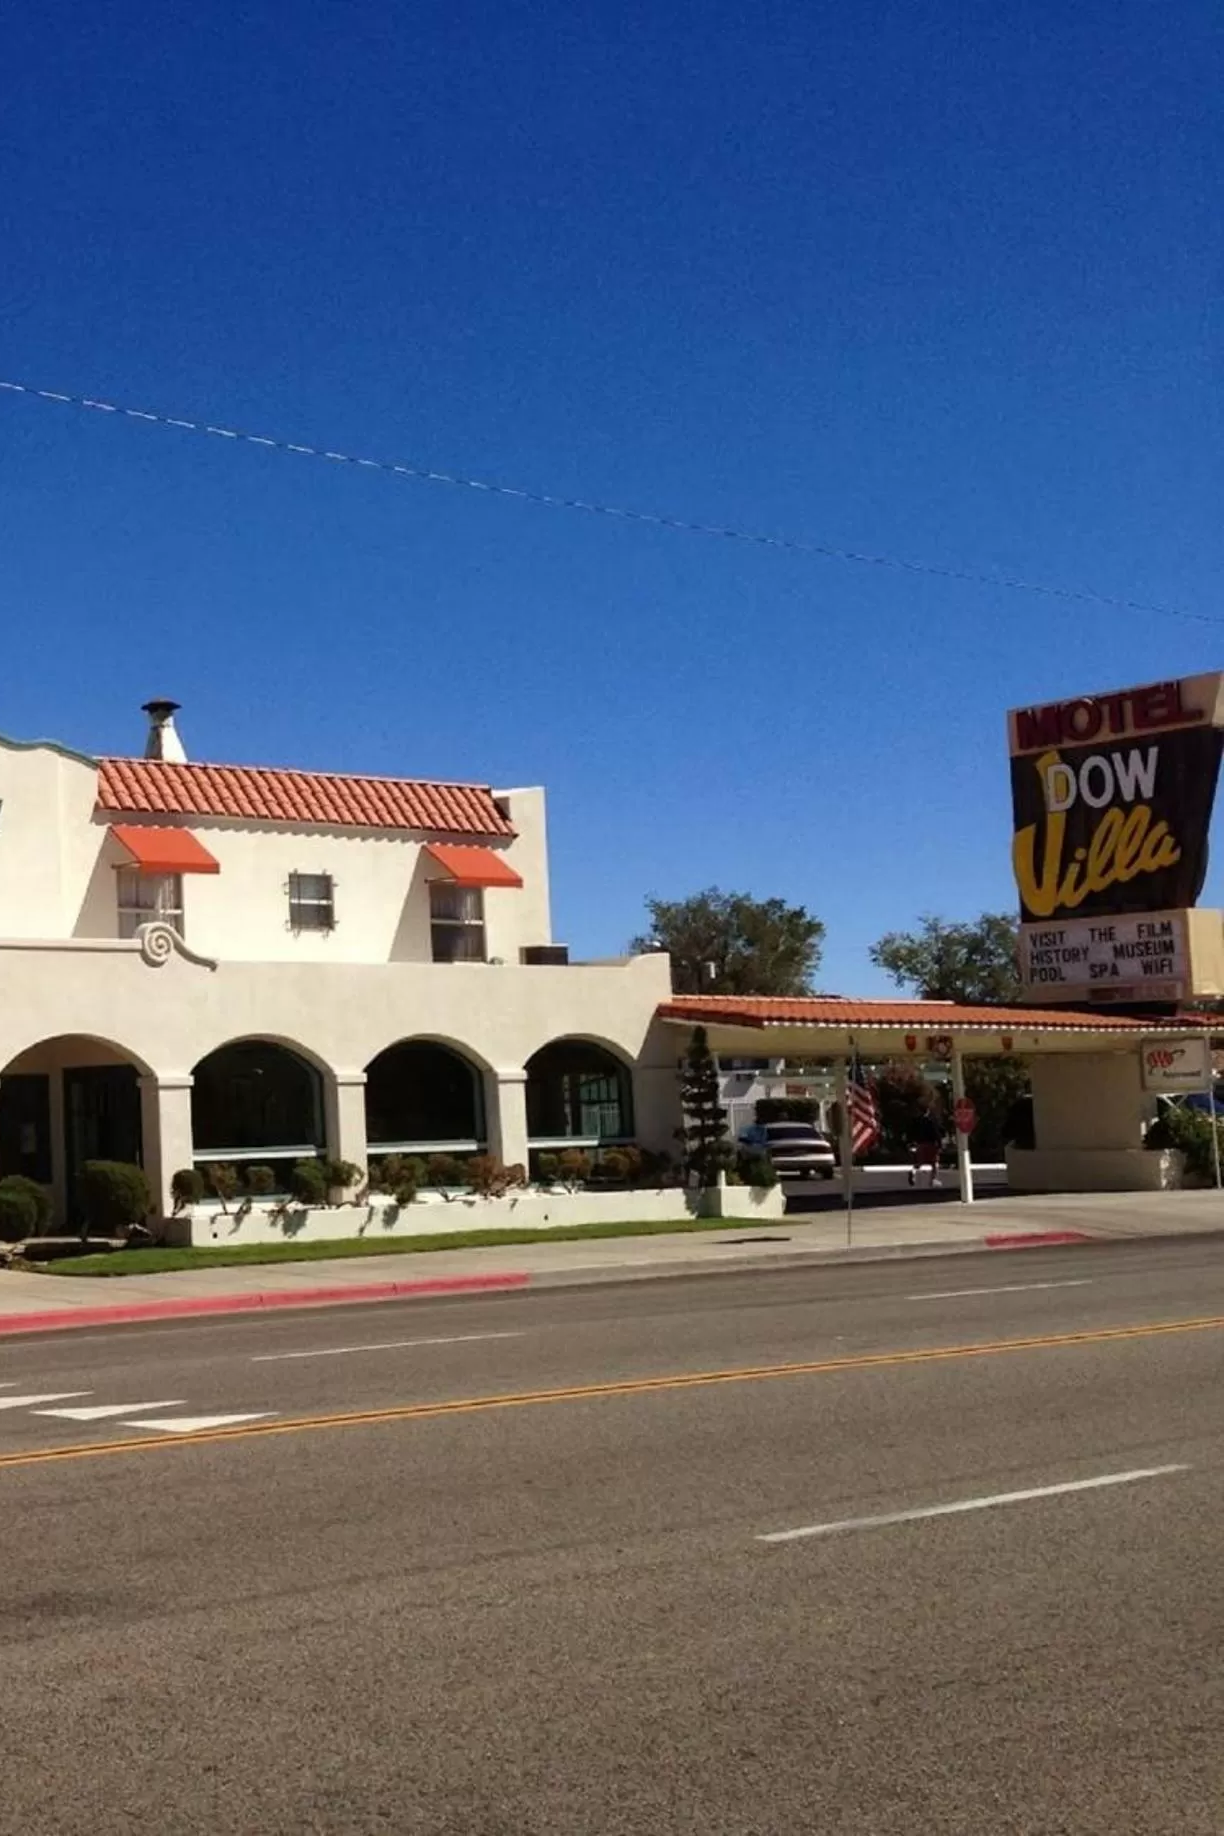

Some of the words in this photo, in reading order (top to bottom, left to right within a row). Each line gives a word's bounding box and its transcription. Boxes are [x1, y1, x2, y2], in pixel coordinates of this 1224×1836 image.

[1016, 680, 1205, 748] MOTEL
[1045, 746, 1159, 813] DOW
[1012, 750, 1181, 916] Villa
[1029, 930, 1067, 949] VISIT
[1088, 926, 1117, 943] THE
[1137, 920, 1173, 939] FILM
[1030, 946, 1089, 965] HISTORY
[1112, 940, 1175, 959] MUSEUM
[1030, 966, 1067, 984] POOL
[1088, 963, 1120, 979] SPA
[1140, 958, 1173, 975] WIFI
